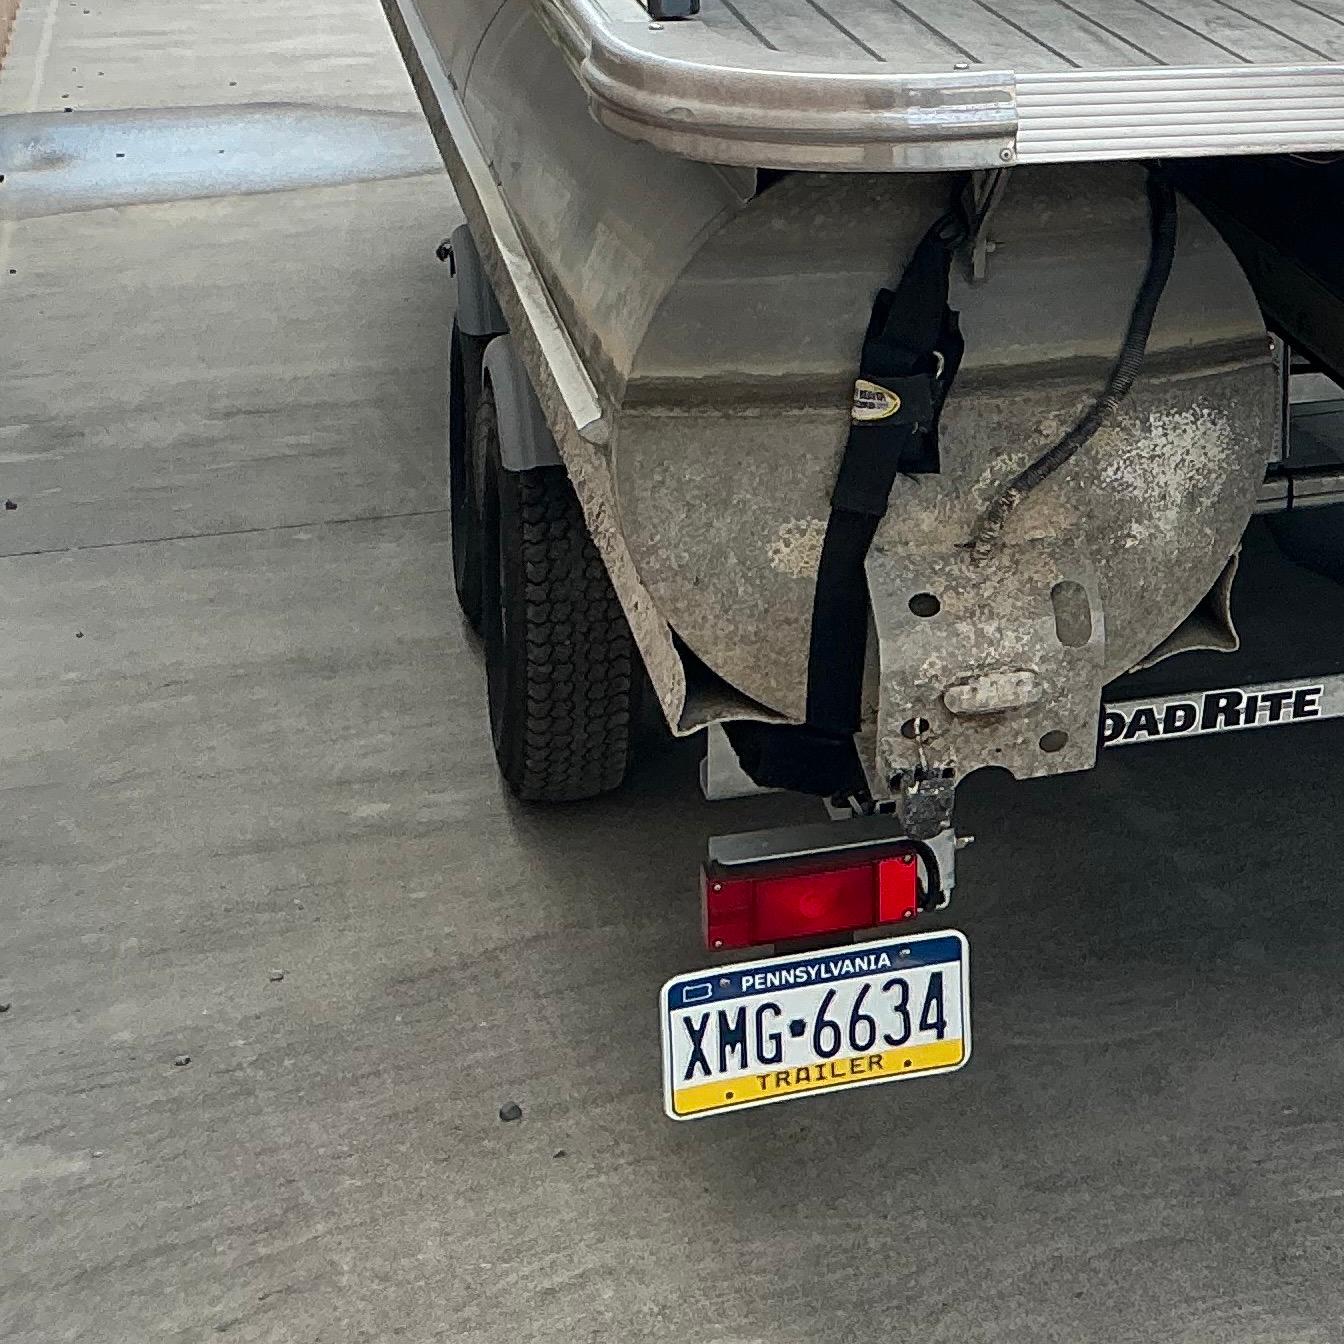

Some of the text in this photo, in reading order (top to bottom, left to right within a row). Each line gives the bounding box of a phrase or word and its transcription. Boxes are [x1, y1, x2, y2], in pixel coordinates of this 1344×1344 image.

[1103, 686, 1324, 745] OADRITE
[741, 952, 892, 992] PENNSYLVANIA
[757, 1053, 884, 1091] TRAILER
